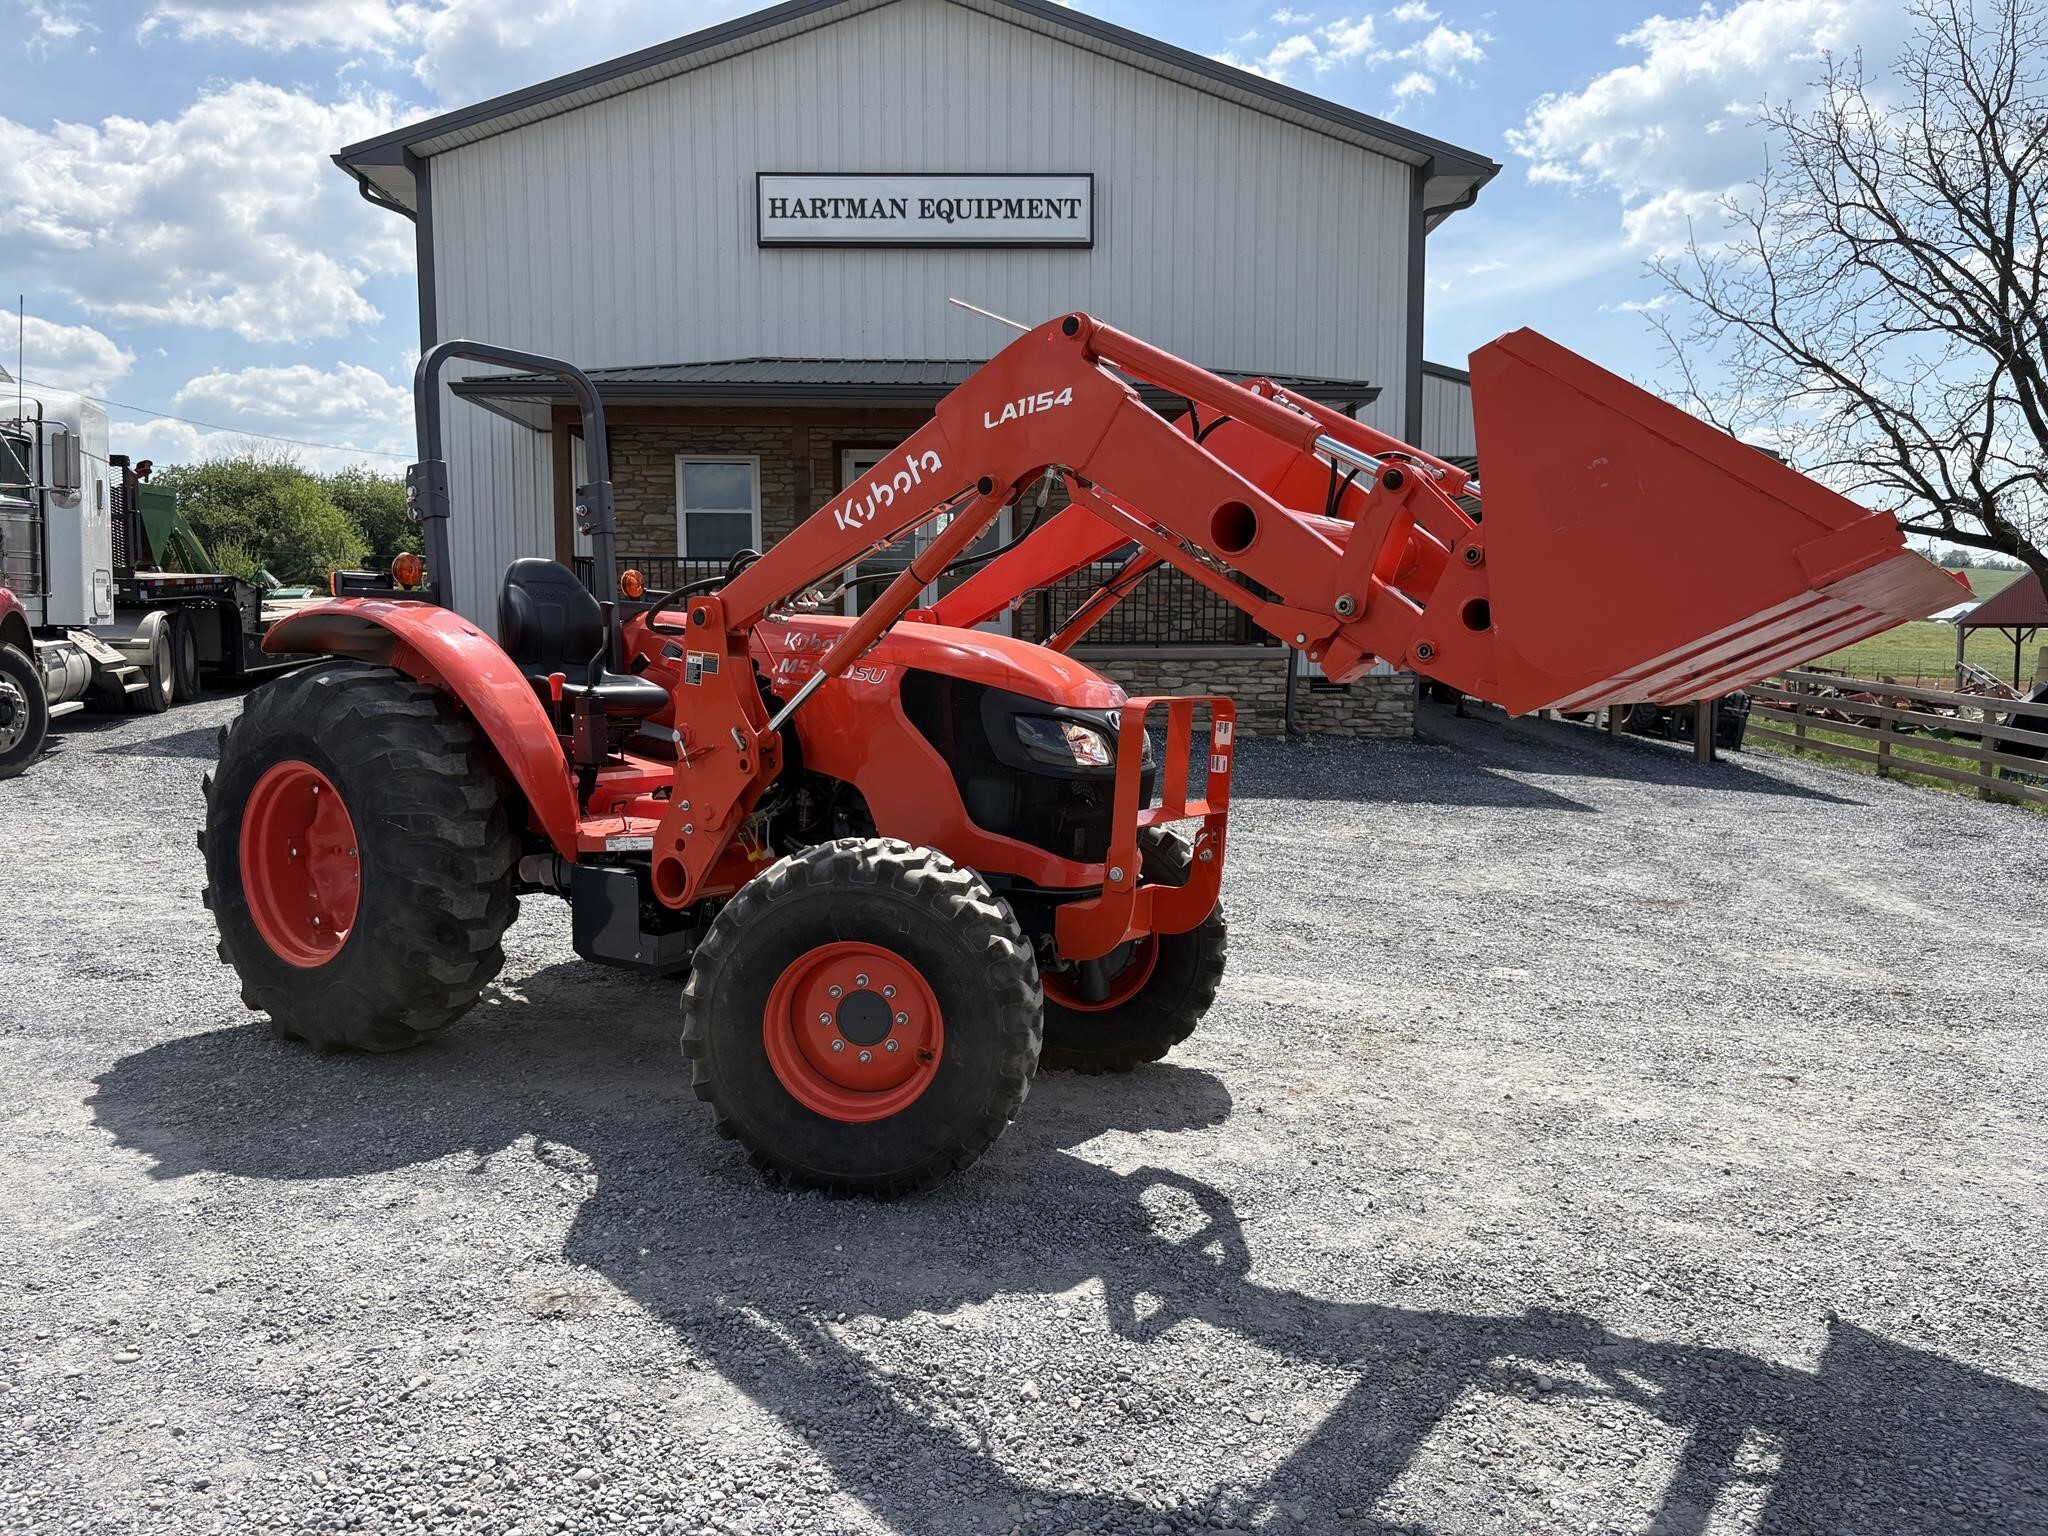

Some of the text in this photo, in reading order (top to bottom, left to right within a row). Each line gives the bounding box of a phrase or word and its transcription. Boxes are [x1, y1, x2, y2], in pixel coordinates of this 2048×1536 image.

[768, 197, 1082, 224] HARTMAN EQUIPMENT
[983, 386, 1073, 429] LA1154
[833, 449, 943, 531] Kubota
